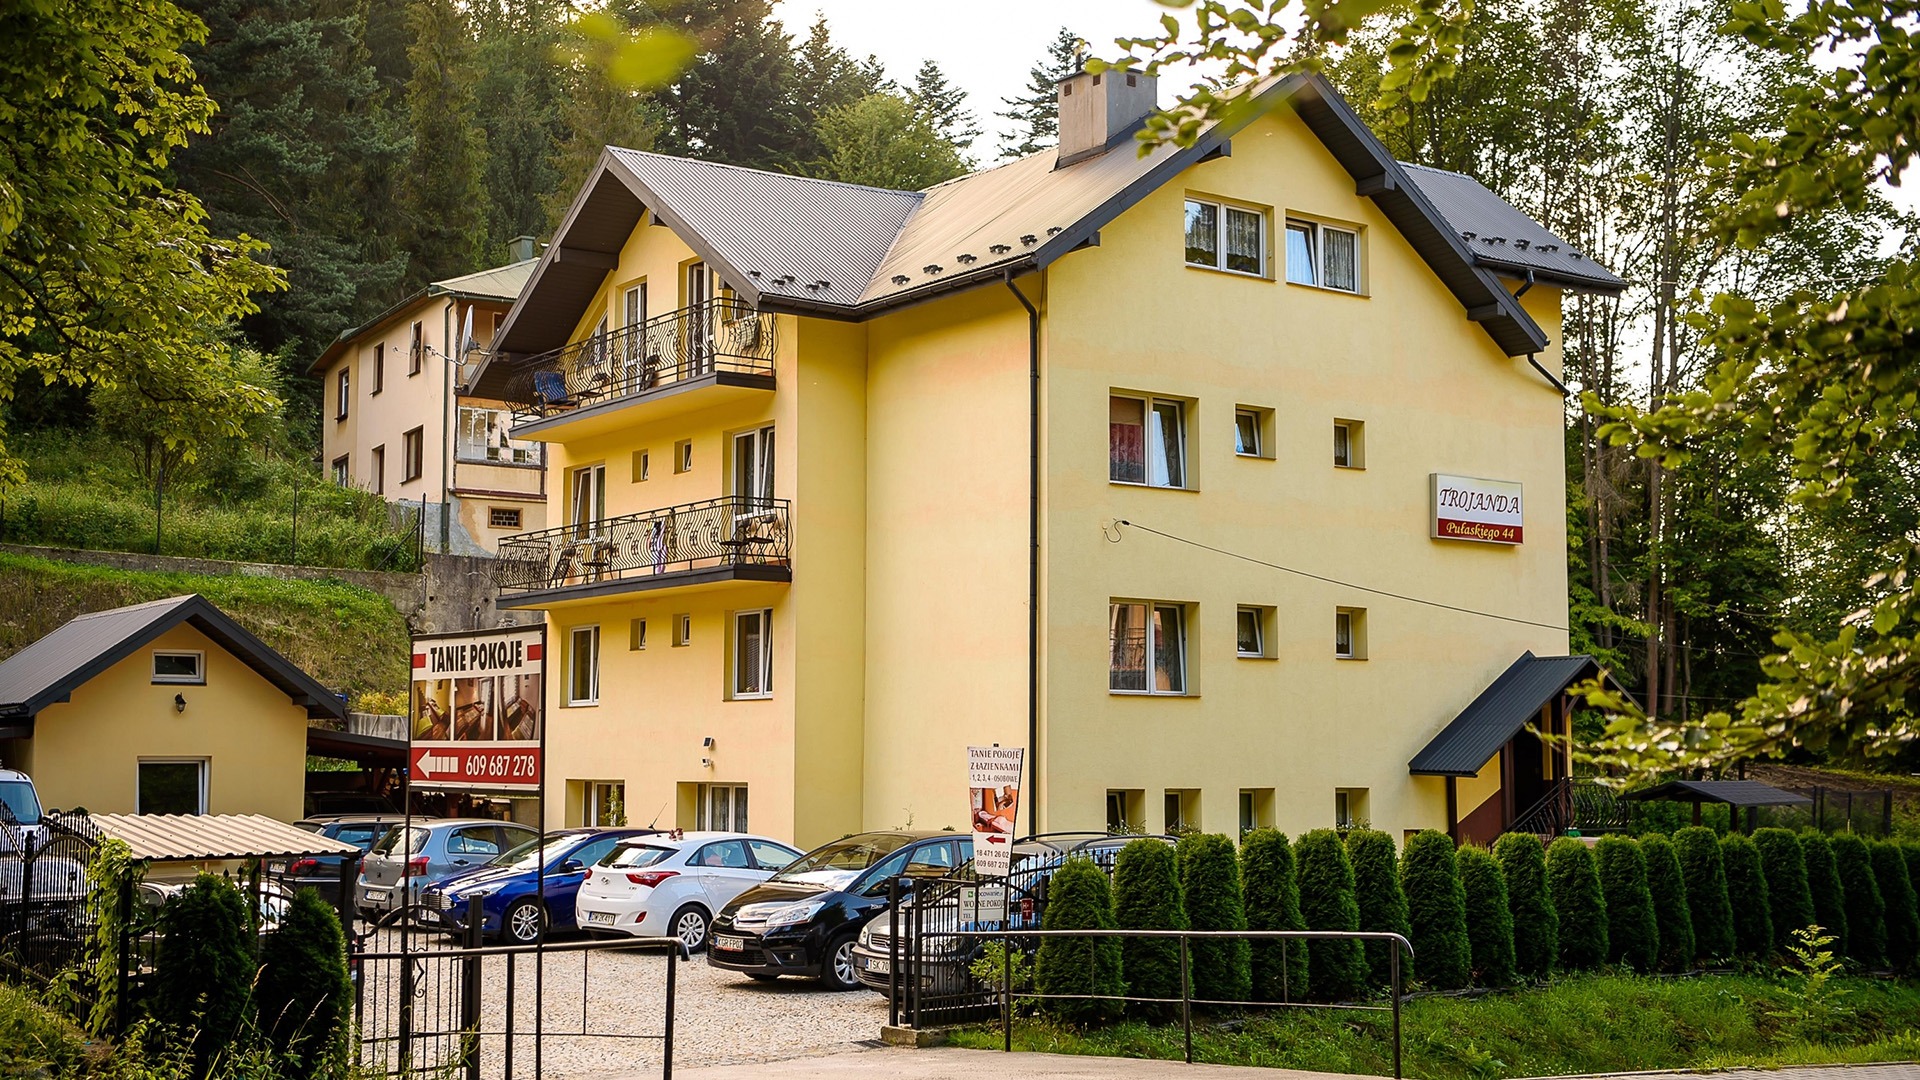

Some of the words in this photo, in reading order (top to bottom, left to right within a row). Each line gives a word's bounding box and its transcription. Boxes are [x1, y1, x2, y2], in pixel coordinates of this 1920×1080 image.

[1440, 487, 1520, 514] TROJANDA
[1446, 522, 1500, 540] Pułaskiego
[1502, 528, 1515, 539] 44
[430, 645, 467, 673] TANIE
[470, 640, 523, 671] POKOJE
[970, 750, 992, 758] TANIE
[993, 750, 1020, 760] POKOJE
[465, 755, 487, 776] 609
[489, 755, 511, 777] 687
[512, 755, 535, 777] 278
[970, 762, 975, 770] Z
[976, 762, 1019, 771] ŁAZIENKAMI
[994, 850, 1001, 858] 26
[963, 900, 985, 908] WONE
[870, 960, 880, 970] TSK
